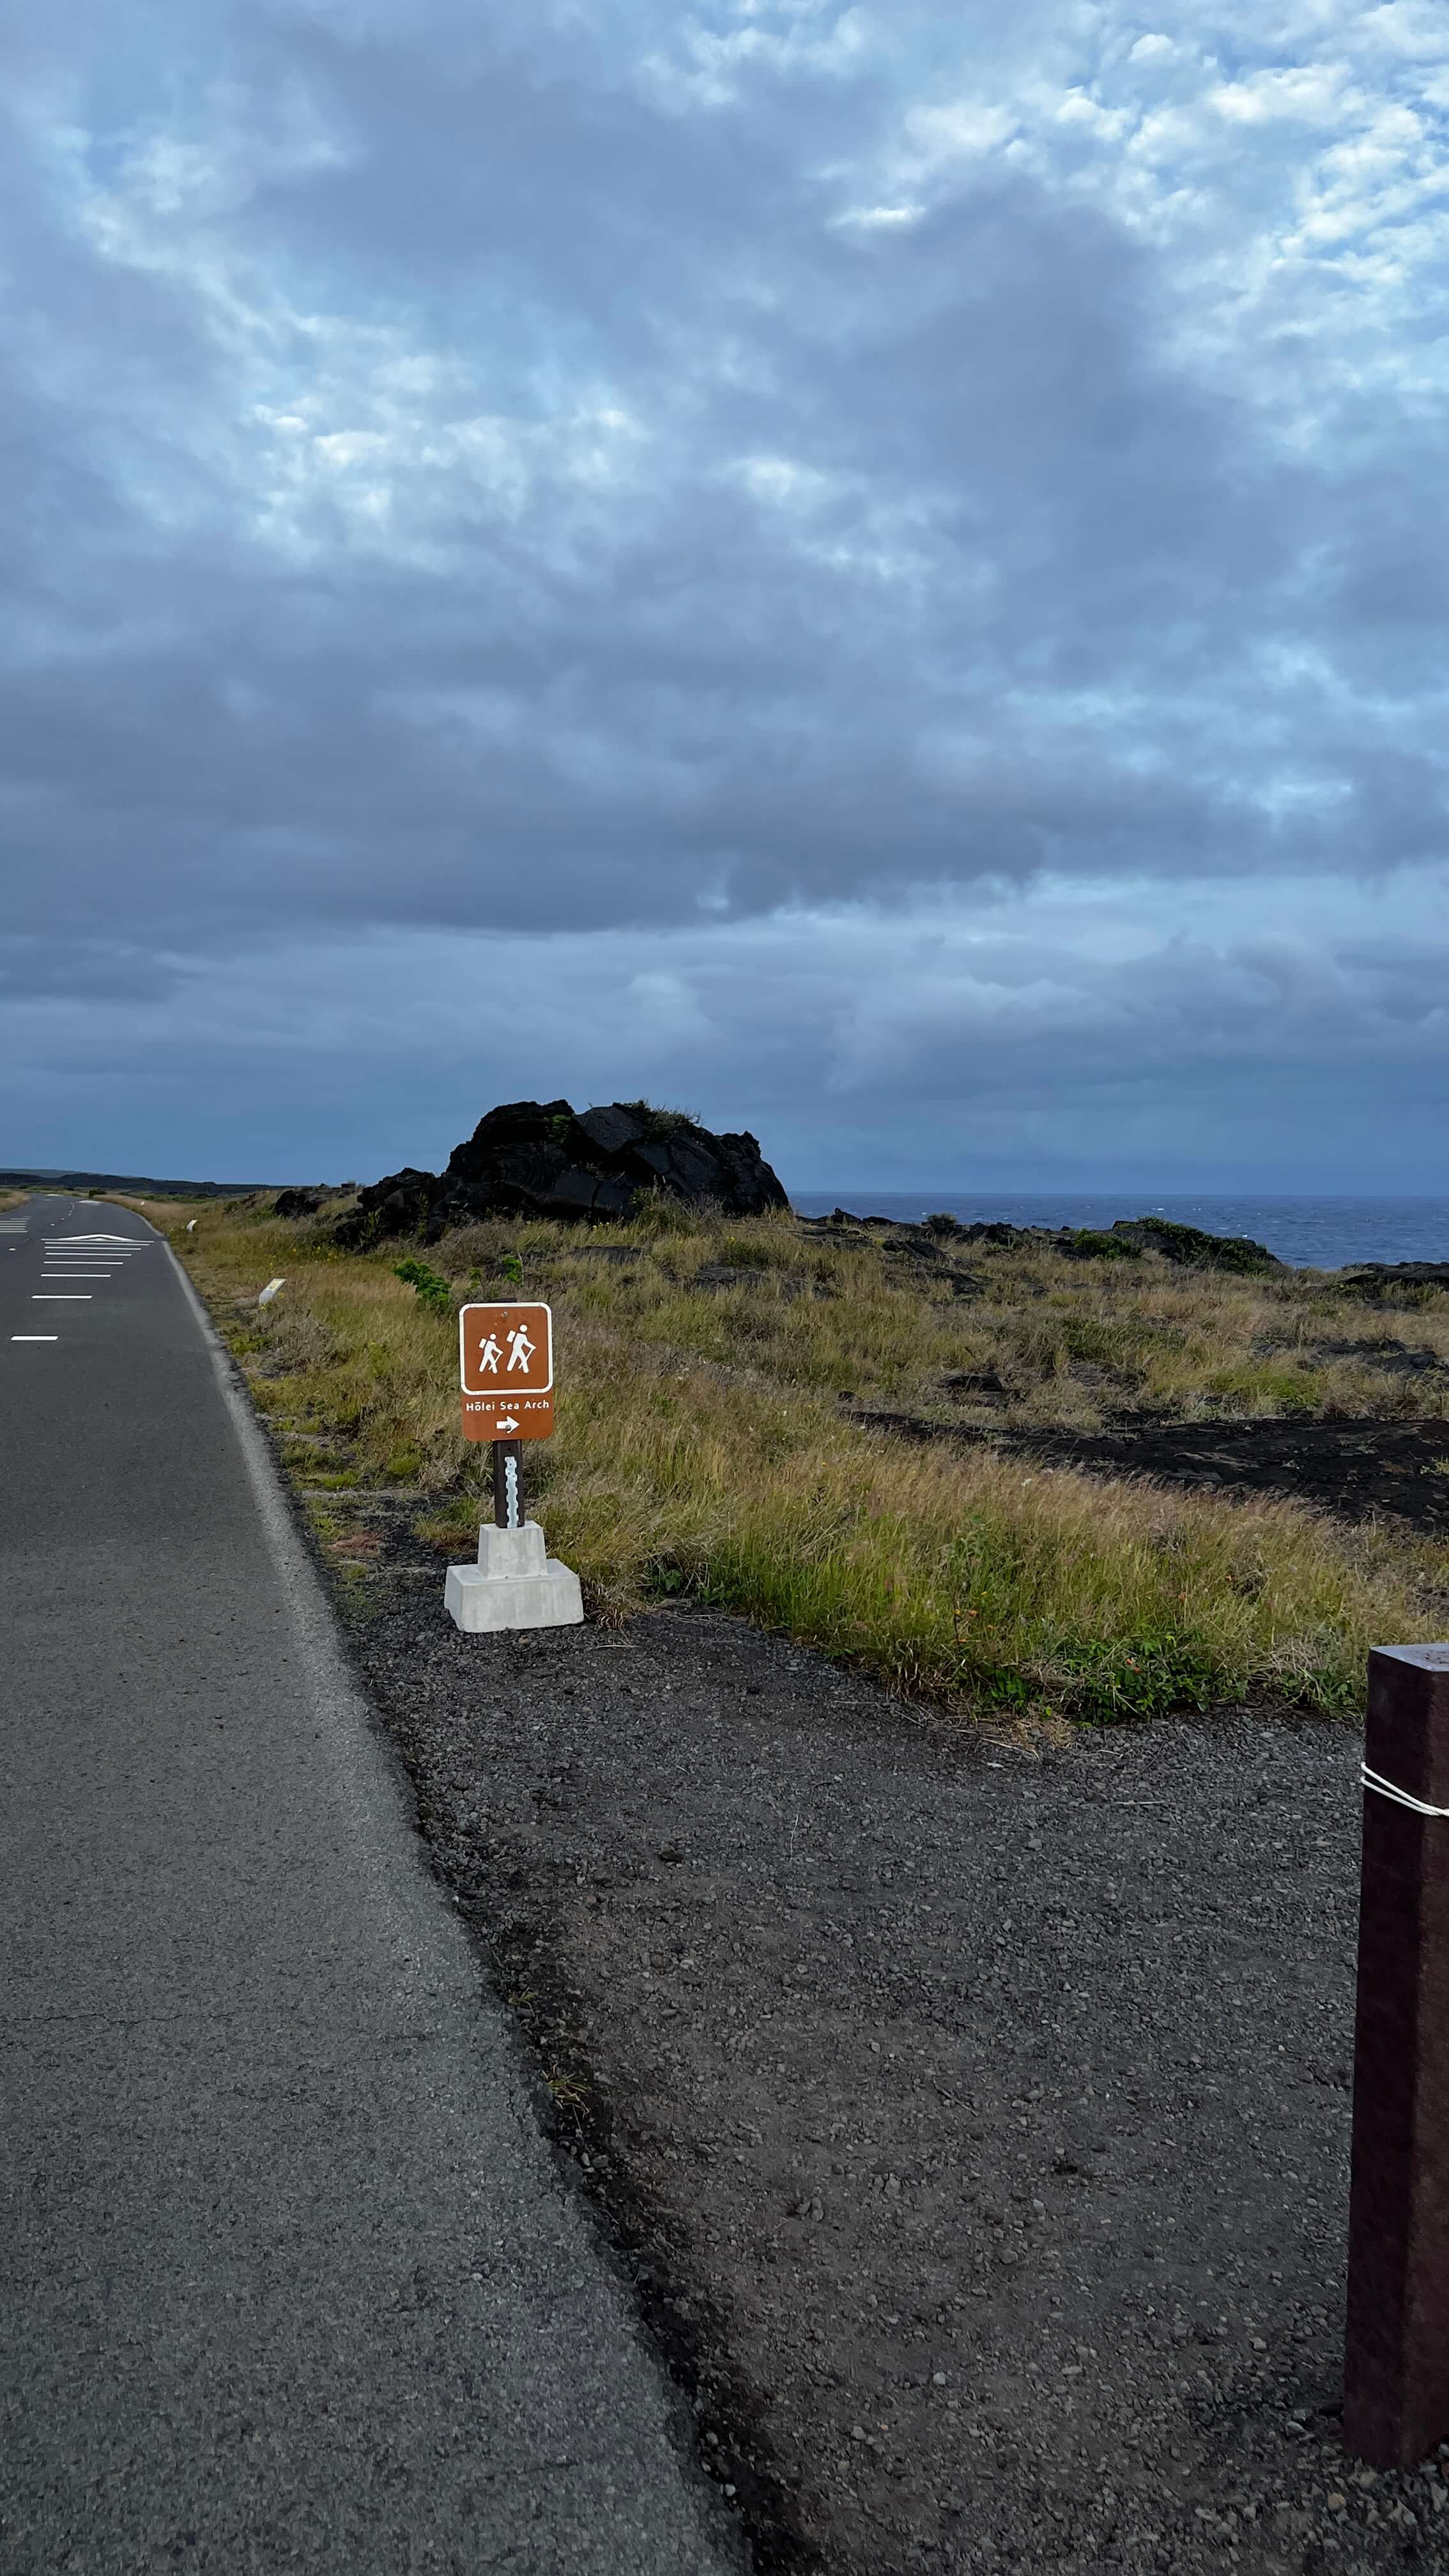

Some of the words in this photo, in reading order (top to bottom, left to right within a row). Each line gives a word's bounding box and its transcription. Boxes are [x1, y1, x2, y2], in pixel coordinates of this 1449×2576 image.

[466, 1401, 495, 1411] Hōlei
[500, 1401, 519, 1410] Sea
[524, 1399, 549, 1409] Arch
